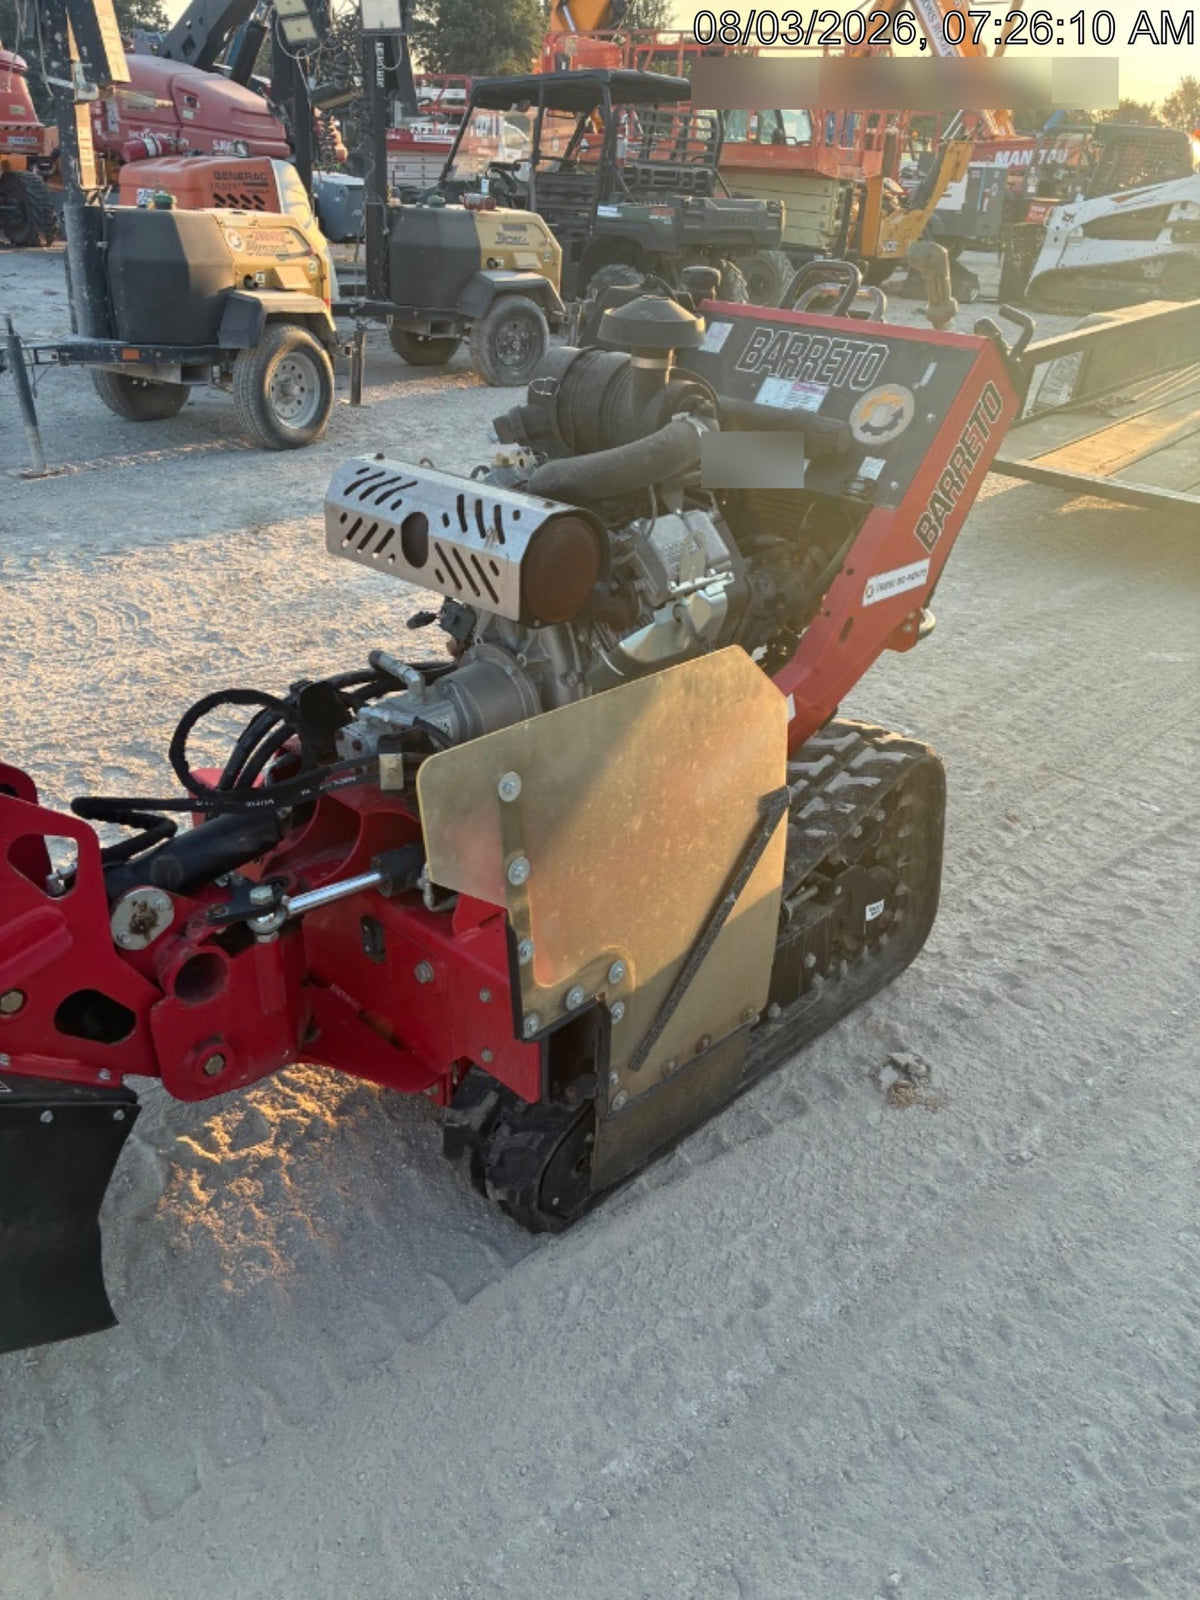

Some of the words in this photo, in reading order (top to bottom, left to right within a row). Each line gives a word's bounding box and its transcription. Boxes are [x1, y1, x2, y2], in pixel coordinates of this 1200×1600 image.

[213, 170, 267, 181] GENERAC
[995, 149, 1069, 165] MANTOU
[735, 327, 890, 392] BARRETO
[914, 380, 1003, 555] BARRETO
